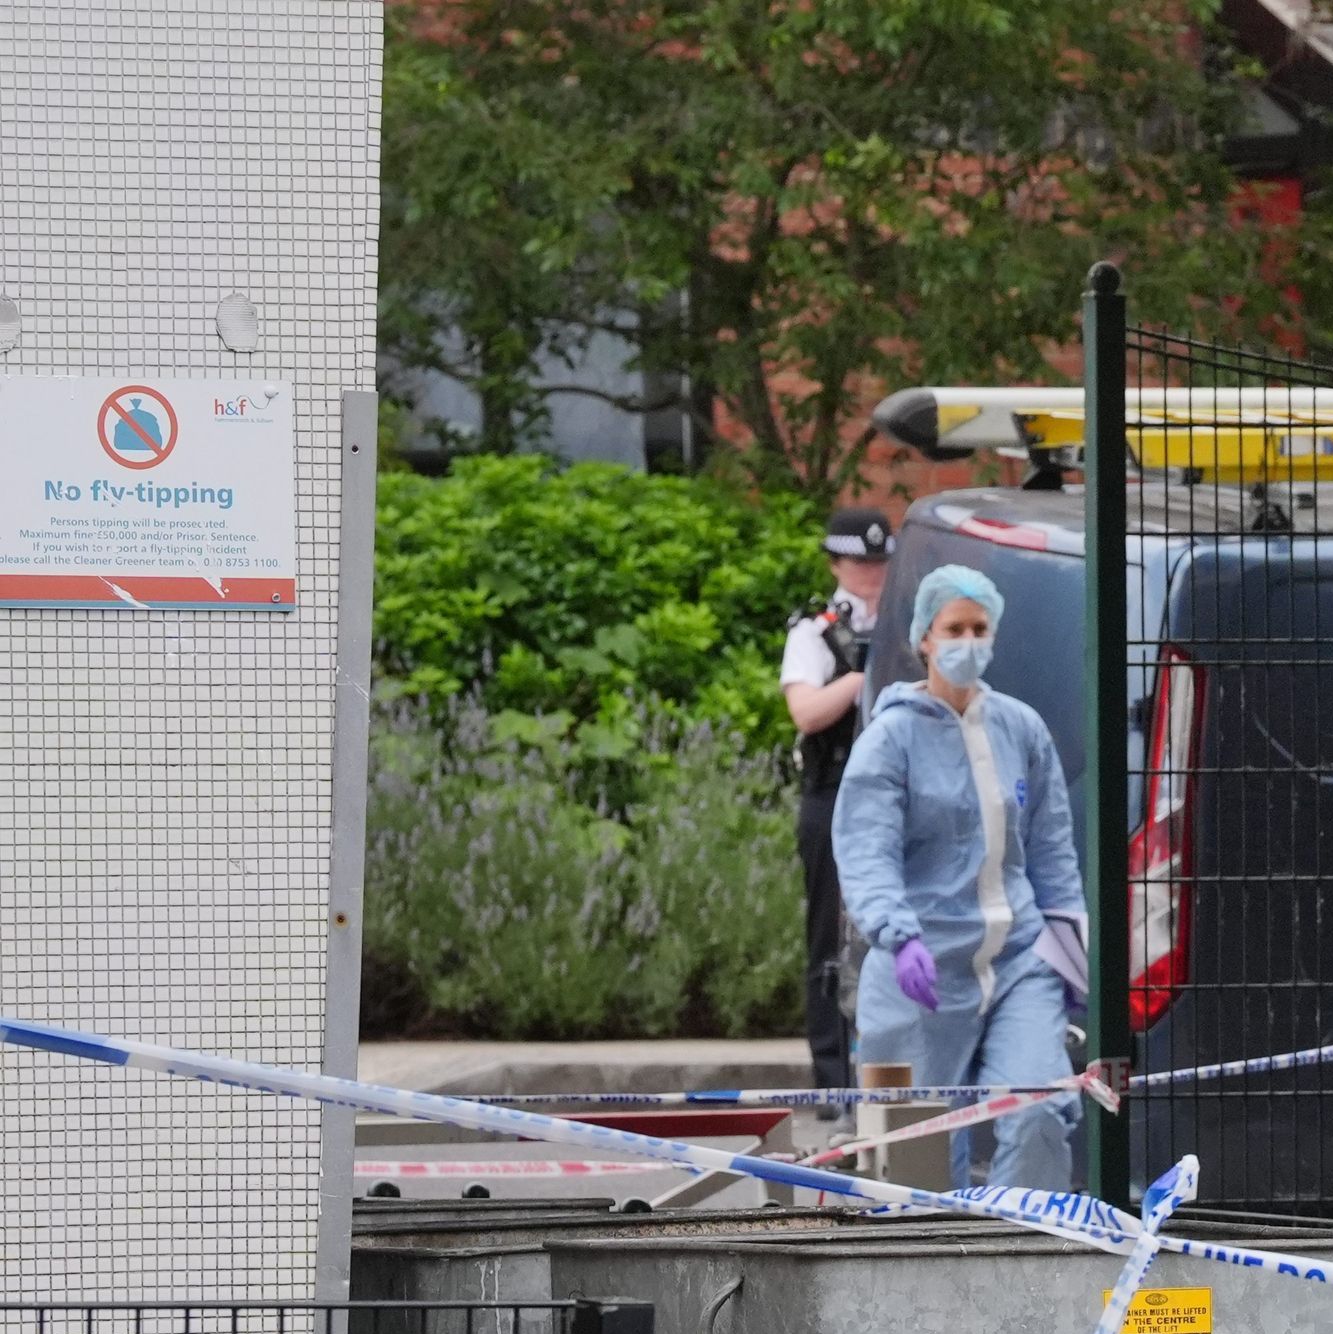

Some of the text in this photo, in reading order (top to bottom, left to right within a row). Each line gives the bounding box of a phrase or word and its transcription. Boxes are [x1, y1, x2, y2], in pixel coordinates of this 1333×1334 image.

[214, 398, 247, 416] h&f
[44, 480, 81, 501] No
[50, 516, 89, 527] Persons
[92, 518, 129, 530] tipping
[133, 518, 150, 528] will
[153, 518, 166, 528] be
[19, 529, 71, 539] Maximum
[140, 531, 173, 541] and/or
[32, 542, 40, 552] If
[43, 544, 62, 554] you
[65, 542, 89, 552] wish
[33, 555, 51, 565] call
[54, 556, 71, 565] the
[74, 556, 112, 566] Cleaner
[115, 556, 156, 567] Greener
[159, 557, 185, 567] team
[225, 558, 250, 568] 8753
[1150, 1308, 1168, 1316] MUST
[1184, 1307, 1206, 1316] LIFTED
[1134, 1318, 1152, 1326] THE
[1157, 1316, 1196, 1325] CENTRE
[1137, 1326, 1145, 1334] OF
[1148, 1325, 1160, 1333] THE
